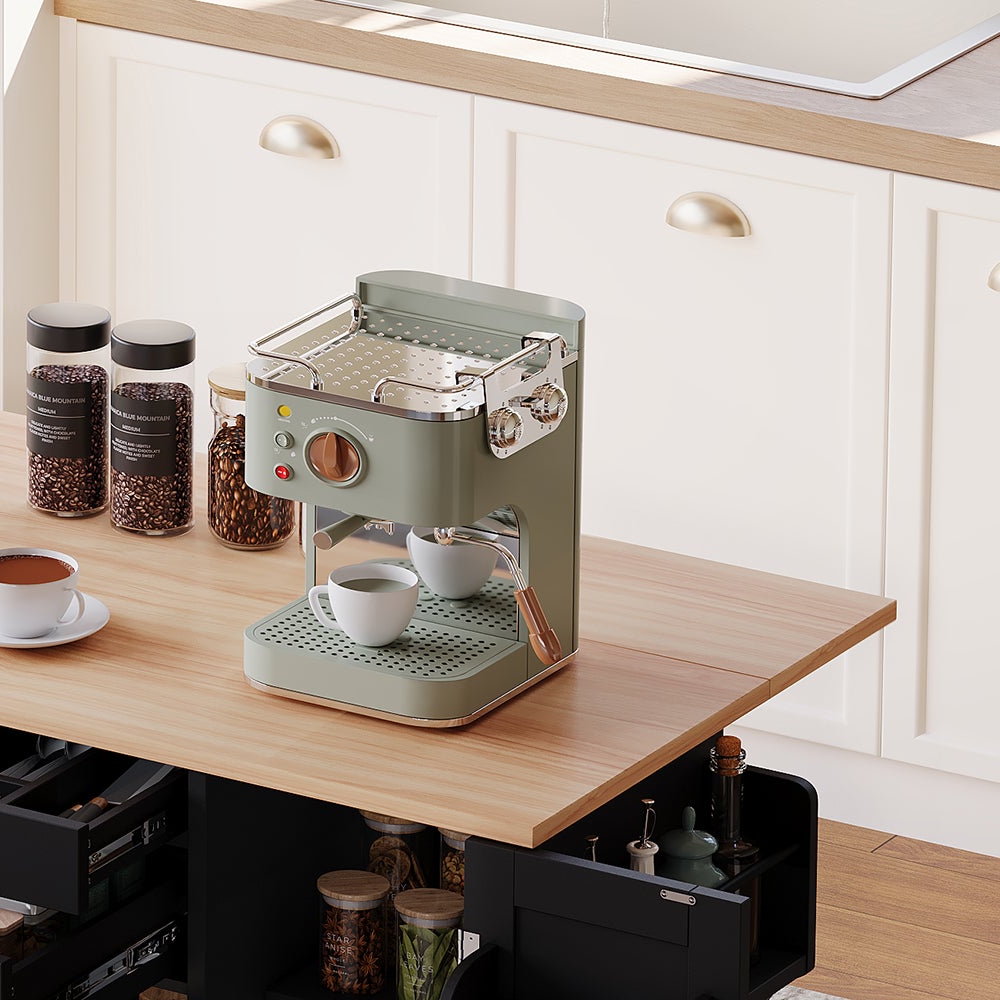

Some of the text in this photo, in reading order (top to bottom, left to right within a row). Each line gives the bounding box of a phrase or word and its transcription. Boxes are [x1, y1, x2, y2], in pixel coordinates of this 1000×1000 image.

[38, 394, 51, 403] BLUE
[37, 406, 57, 414] MEDIUM
[122, 412, 136, 421] BLUE
[121, 424, 141, 432] MEDIUM
[326, 932, 350, 944] STAR
[325, 942, 351, 955] ANISE
[406, 951, 424, 961] BAY
